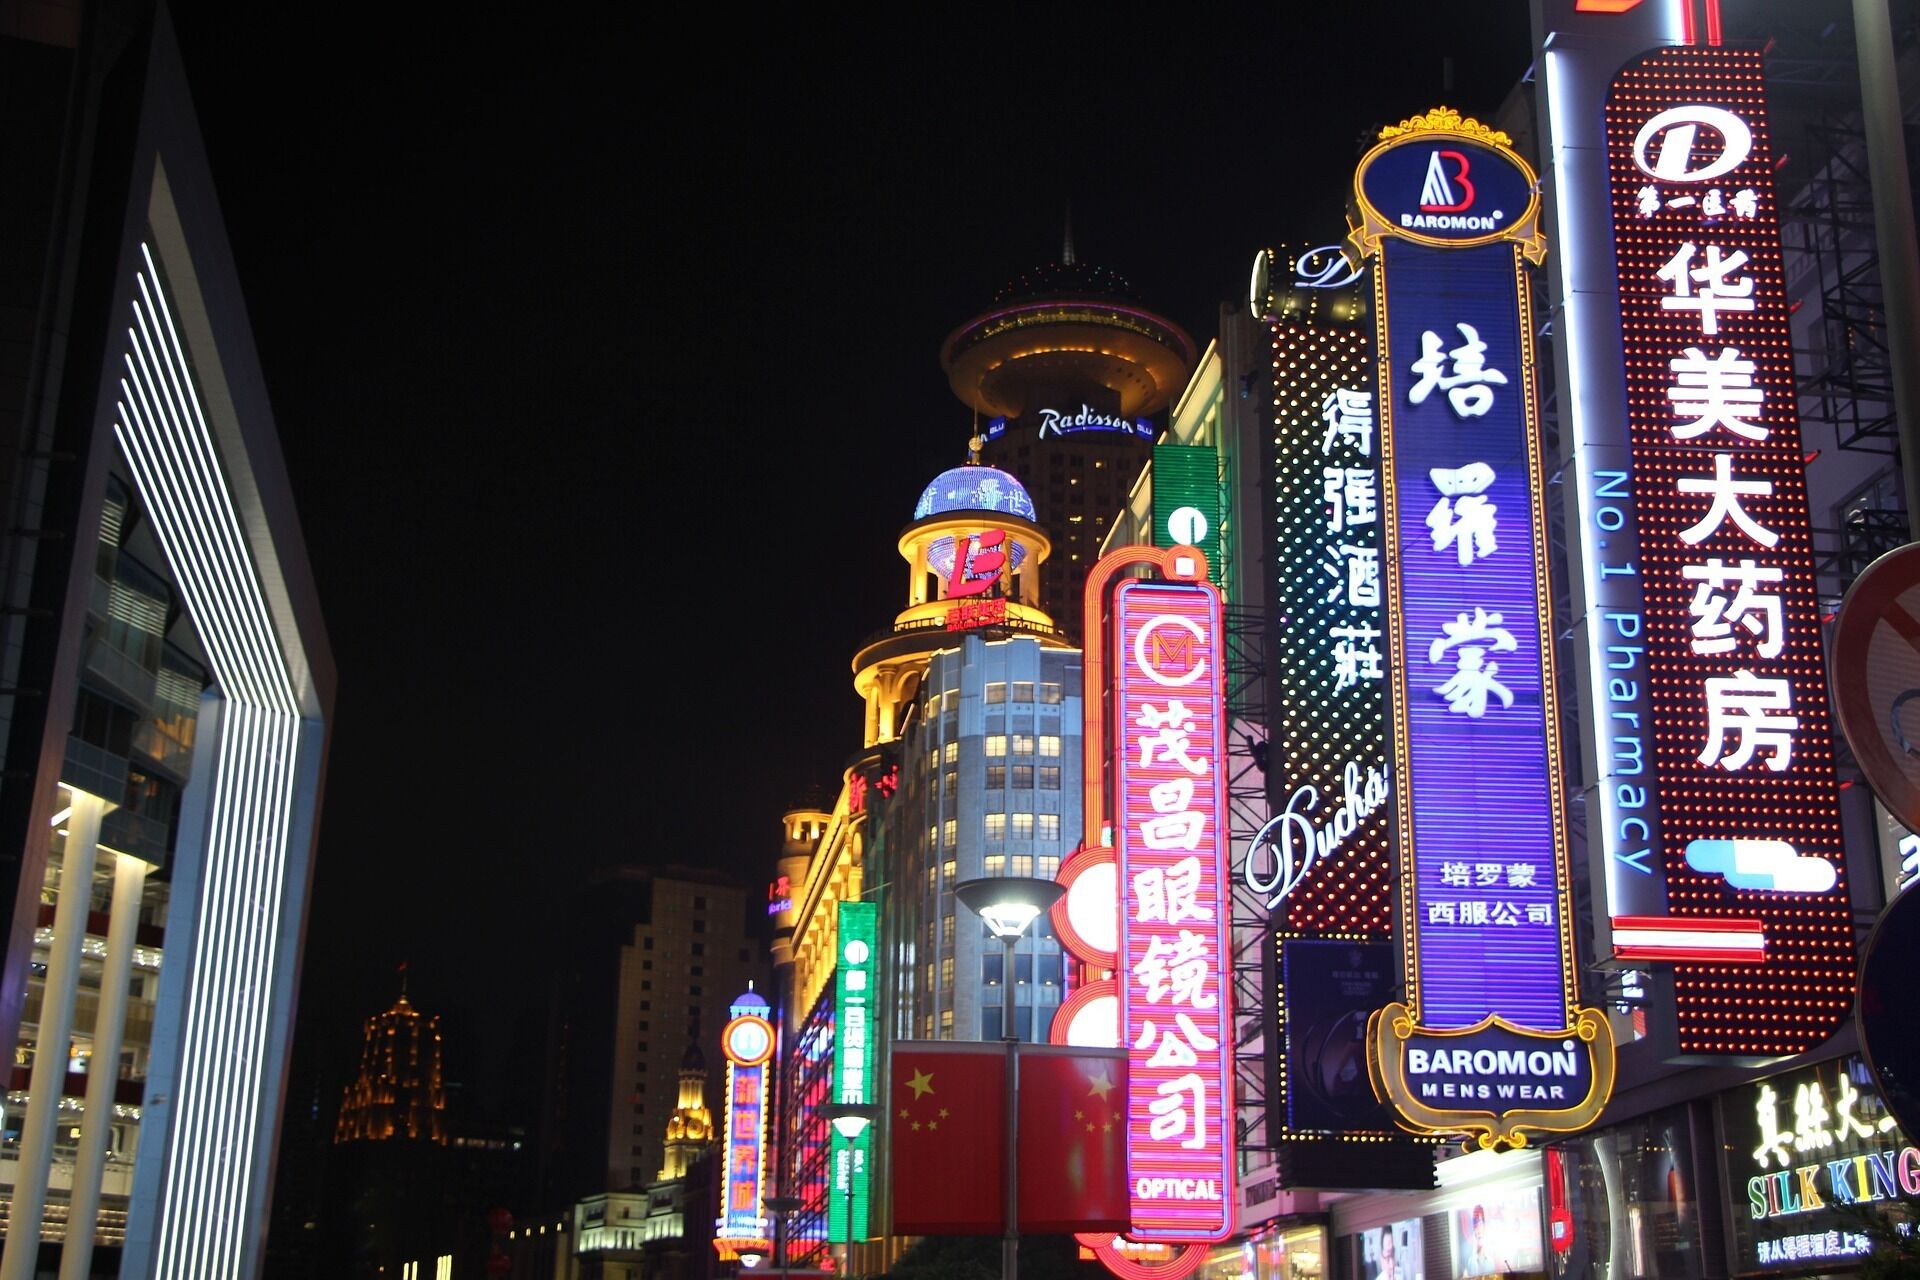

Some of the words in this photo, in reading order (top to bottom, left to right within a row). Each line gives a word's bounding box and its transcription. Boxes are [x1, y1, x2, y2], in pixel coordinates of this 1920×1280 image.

[1039, 404, 1134, 440] Radisson
[1657, 243, 1798, 772] 华美大药房
[1604, 612, 1653, 875] Pharmacy
[1440, 862, 1536, 888] 培罗蒙
[1133, 699, 1218, 1149] 茂昌眼镜公司
[1427, 901, 1552, 926] 西服公司
[1423, 1084, 1490, 1098] MENS
[1498, 1085, 1564, 1099] WEAR
[731, 1076, 759, 1211] 新世界城
[1137, 1177, 1221, 1201] OPTICAL
[1748, 1165, 1825, 1220] SILK
[1827, 1147, 1920, 1205] KING
